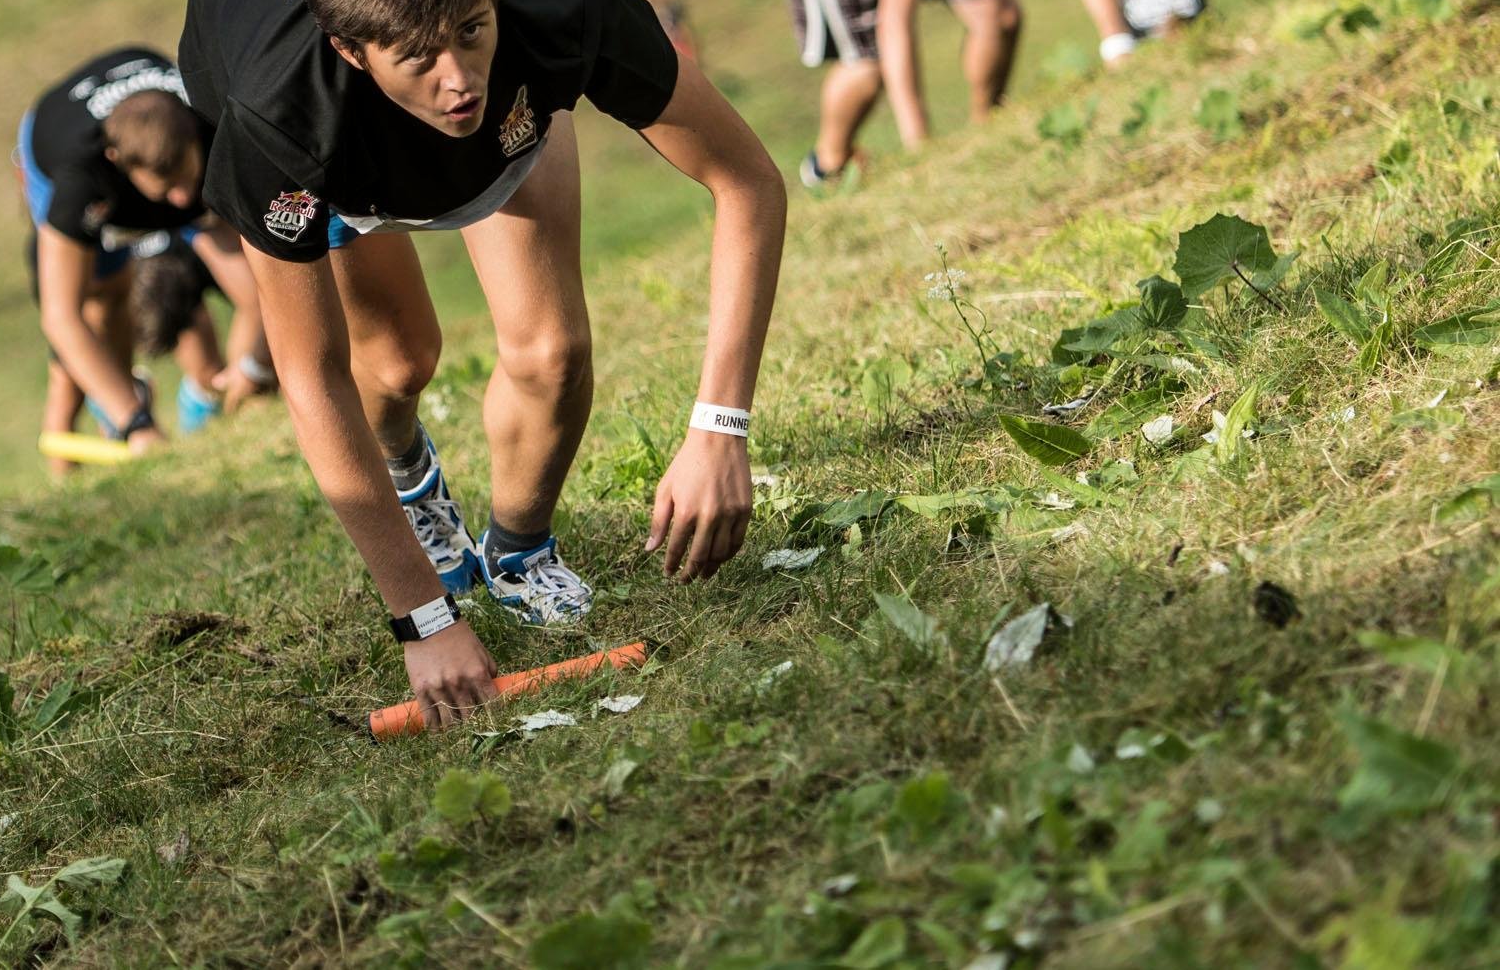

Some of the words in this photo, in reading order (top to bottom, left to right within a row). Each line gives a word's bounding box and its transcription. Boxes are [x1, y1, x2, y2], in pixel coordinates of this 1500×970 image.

[266, 210, 305, 227] 400
[269, 200, 293, 213] Red
[293, 204, 315, 219] Bull
